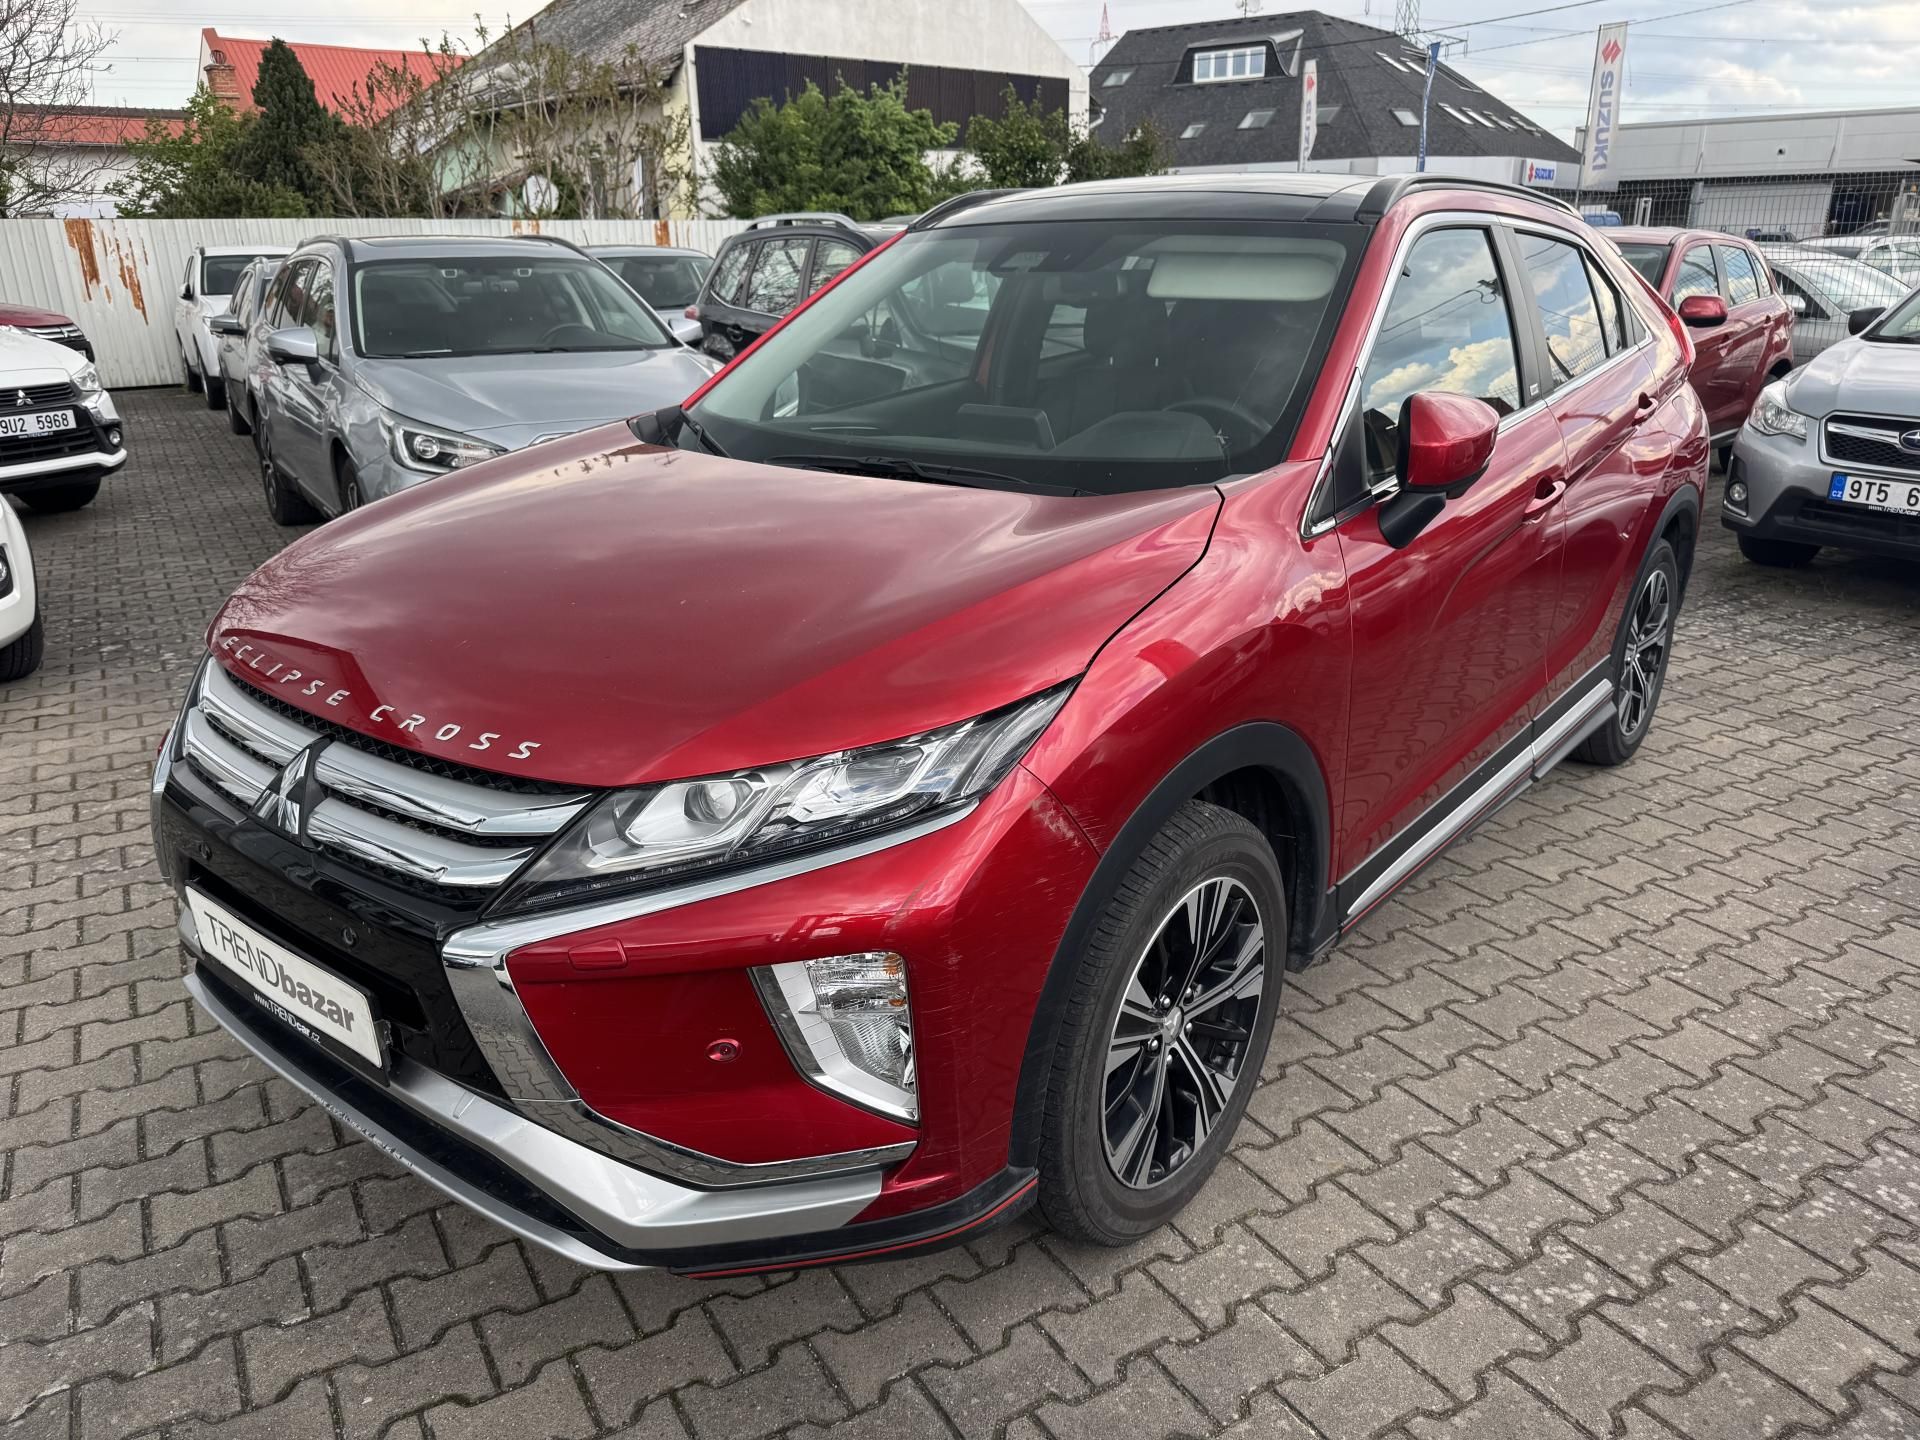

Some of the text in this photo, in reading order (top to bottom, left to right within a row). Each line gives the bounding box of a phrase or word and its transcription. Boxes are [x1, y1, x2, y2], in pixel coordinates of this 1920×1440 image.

[1592, 70, 1614, 171] SUZUKI
[1534, 167, 1555, 181] SUZUKI
[0, 418, 27, 435] 9U2
[36, 413, 69, 430] 5968
[1849, 480, 1891, 503] 9T5
[222, 636, 541, 760] ECLIPSE CROSS
[204, 910, 355, 1032] TRENDbazar
